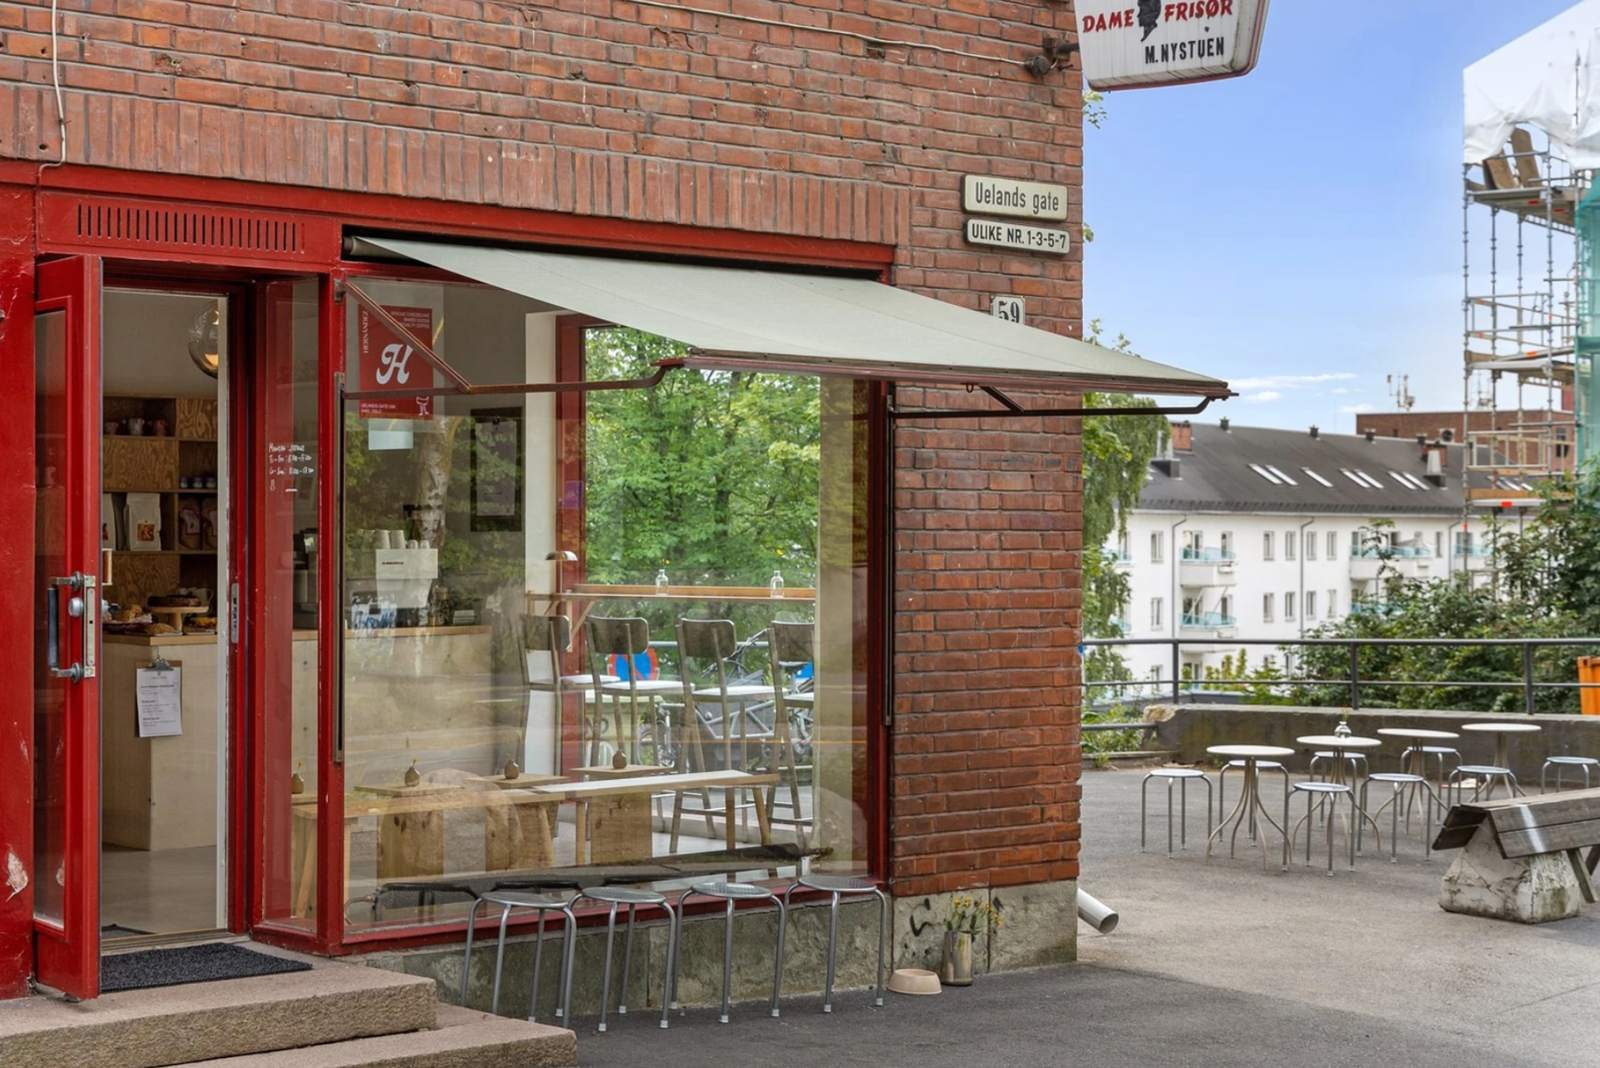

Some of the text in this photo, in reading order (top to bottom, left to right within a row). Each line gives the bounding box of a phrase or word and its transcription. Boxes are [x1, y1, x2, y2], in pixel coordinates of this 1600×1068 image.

[1082, 0, 1233, 33] DAME FRISØR
[975, 182, 1059, 215] Uelands gate
[972, 223, 1067, 249] ULIKE NR. 1-3-5-7
[998, 300, 1020, 324] 59
[376, 343, 413, 385] H
